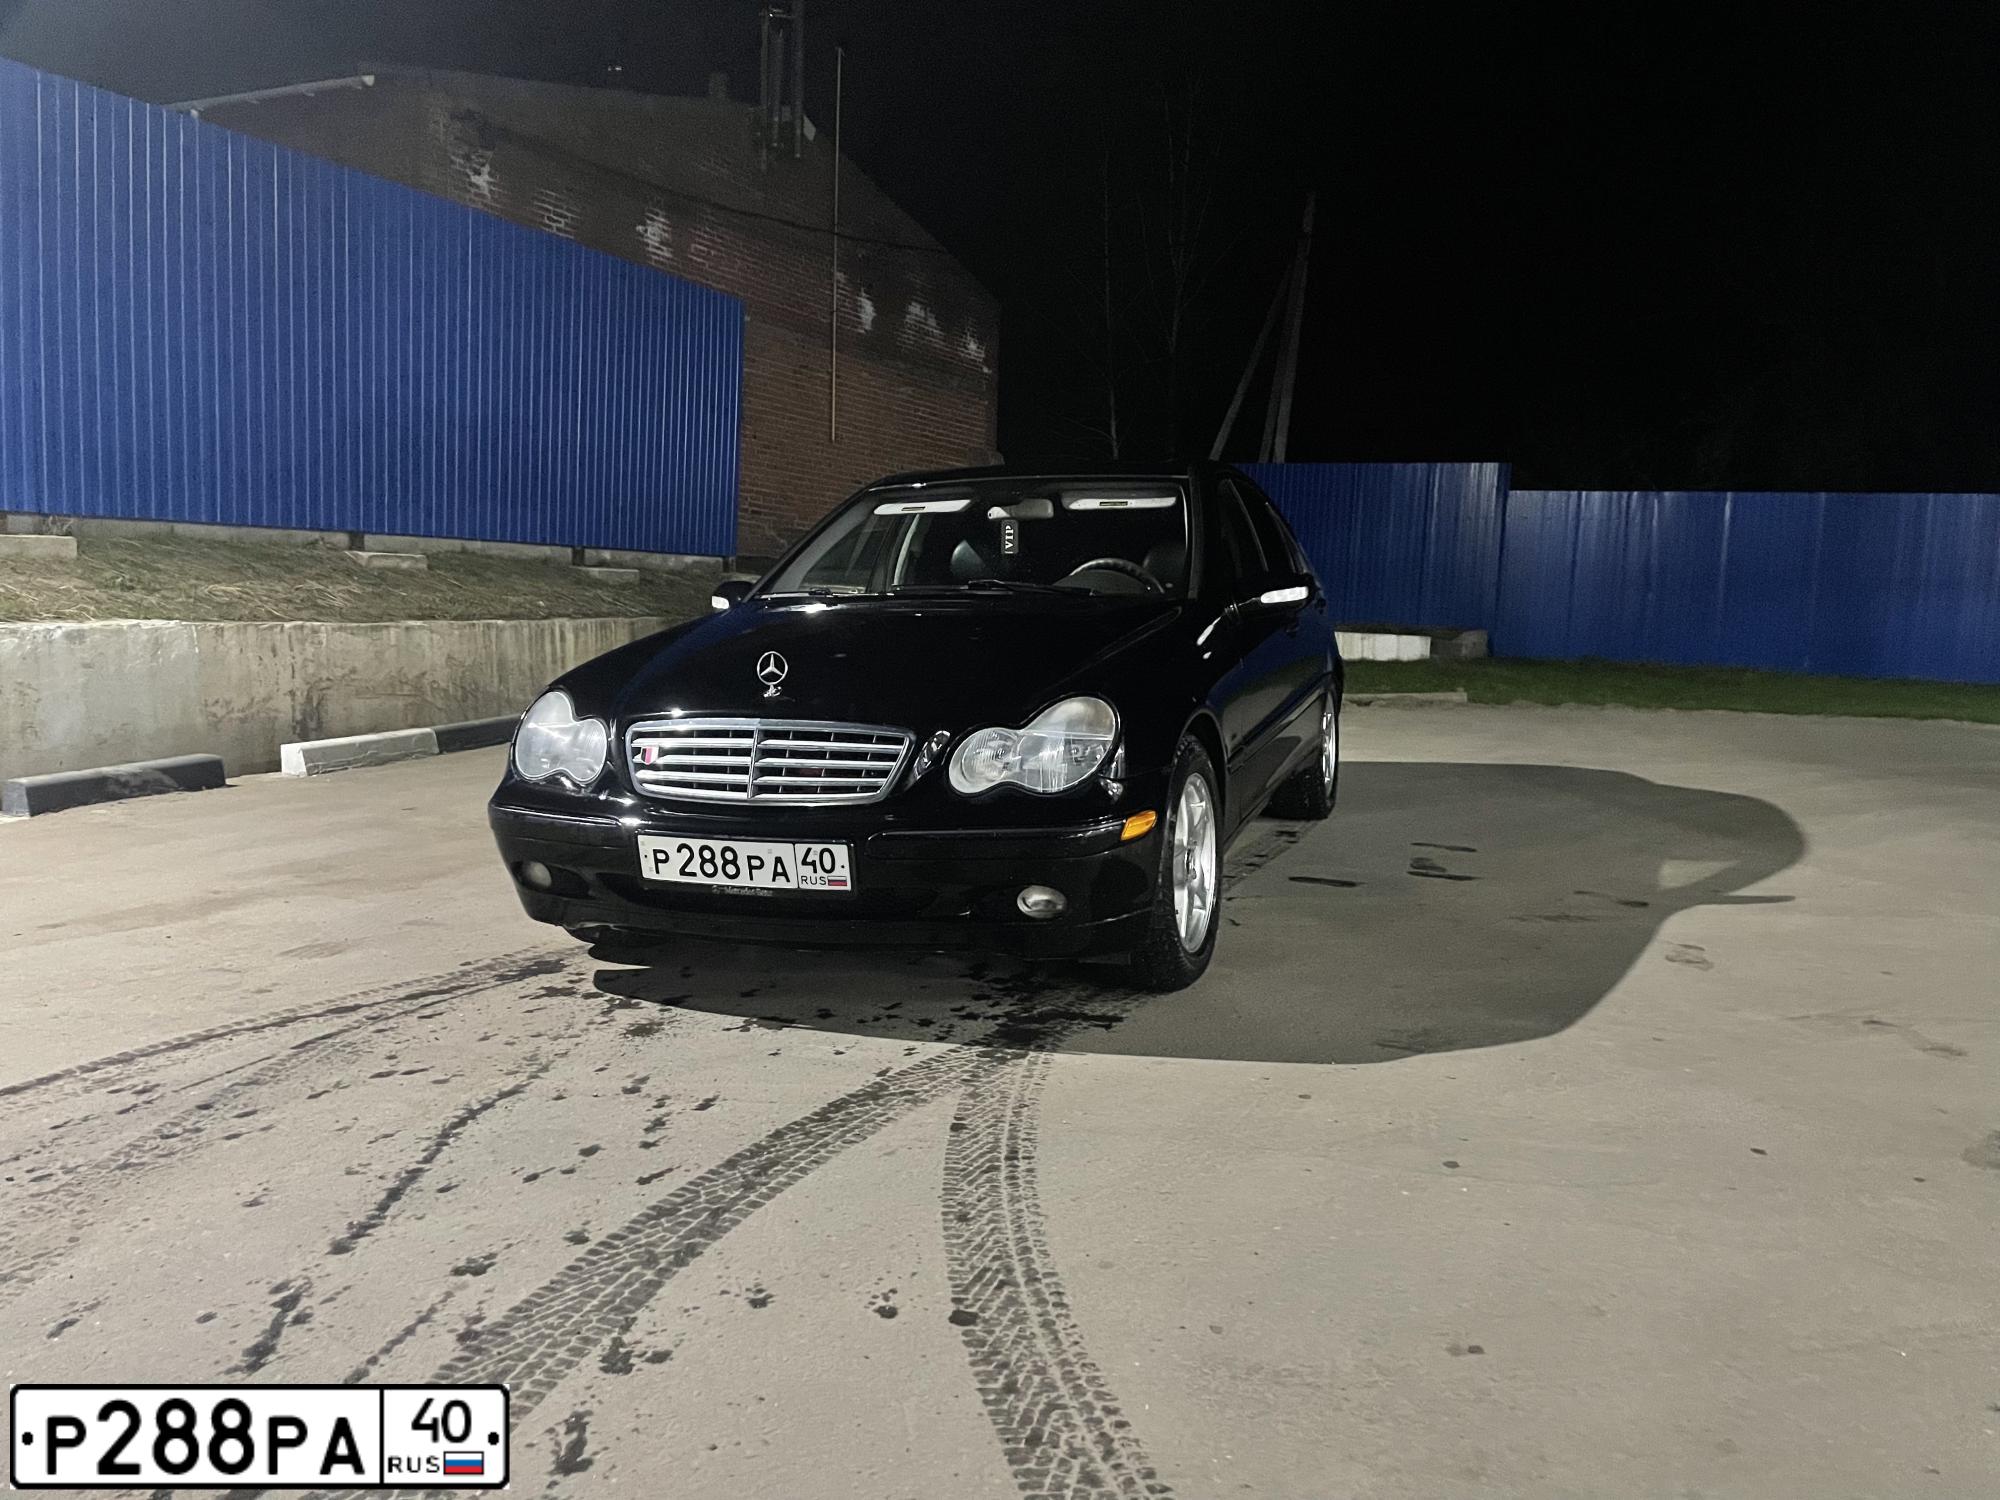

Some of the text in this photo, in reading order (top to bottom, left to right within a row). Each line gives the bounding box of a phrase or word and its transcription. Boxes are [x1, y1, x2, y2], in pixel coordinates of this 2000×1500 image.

[1005, 525, 1014, 549] VIP
[801, 847, 836, 874] 40
[801, 875, 827, 886] RUS
